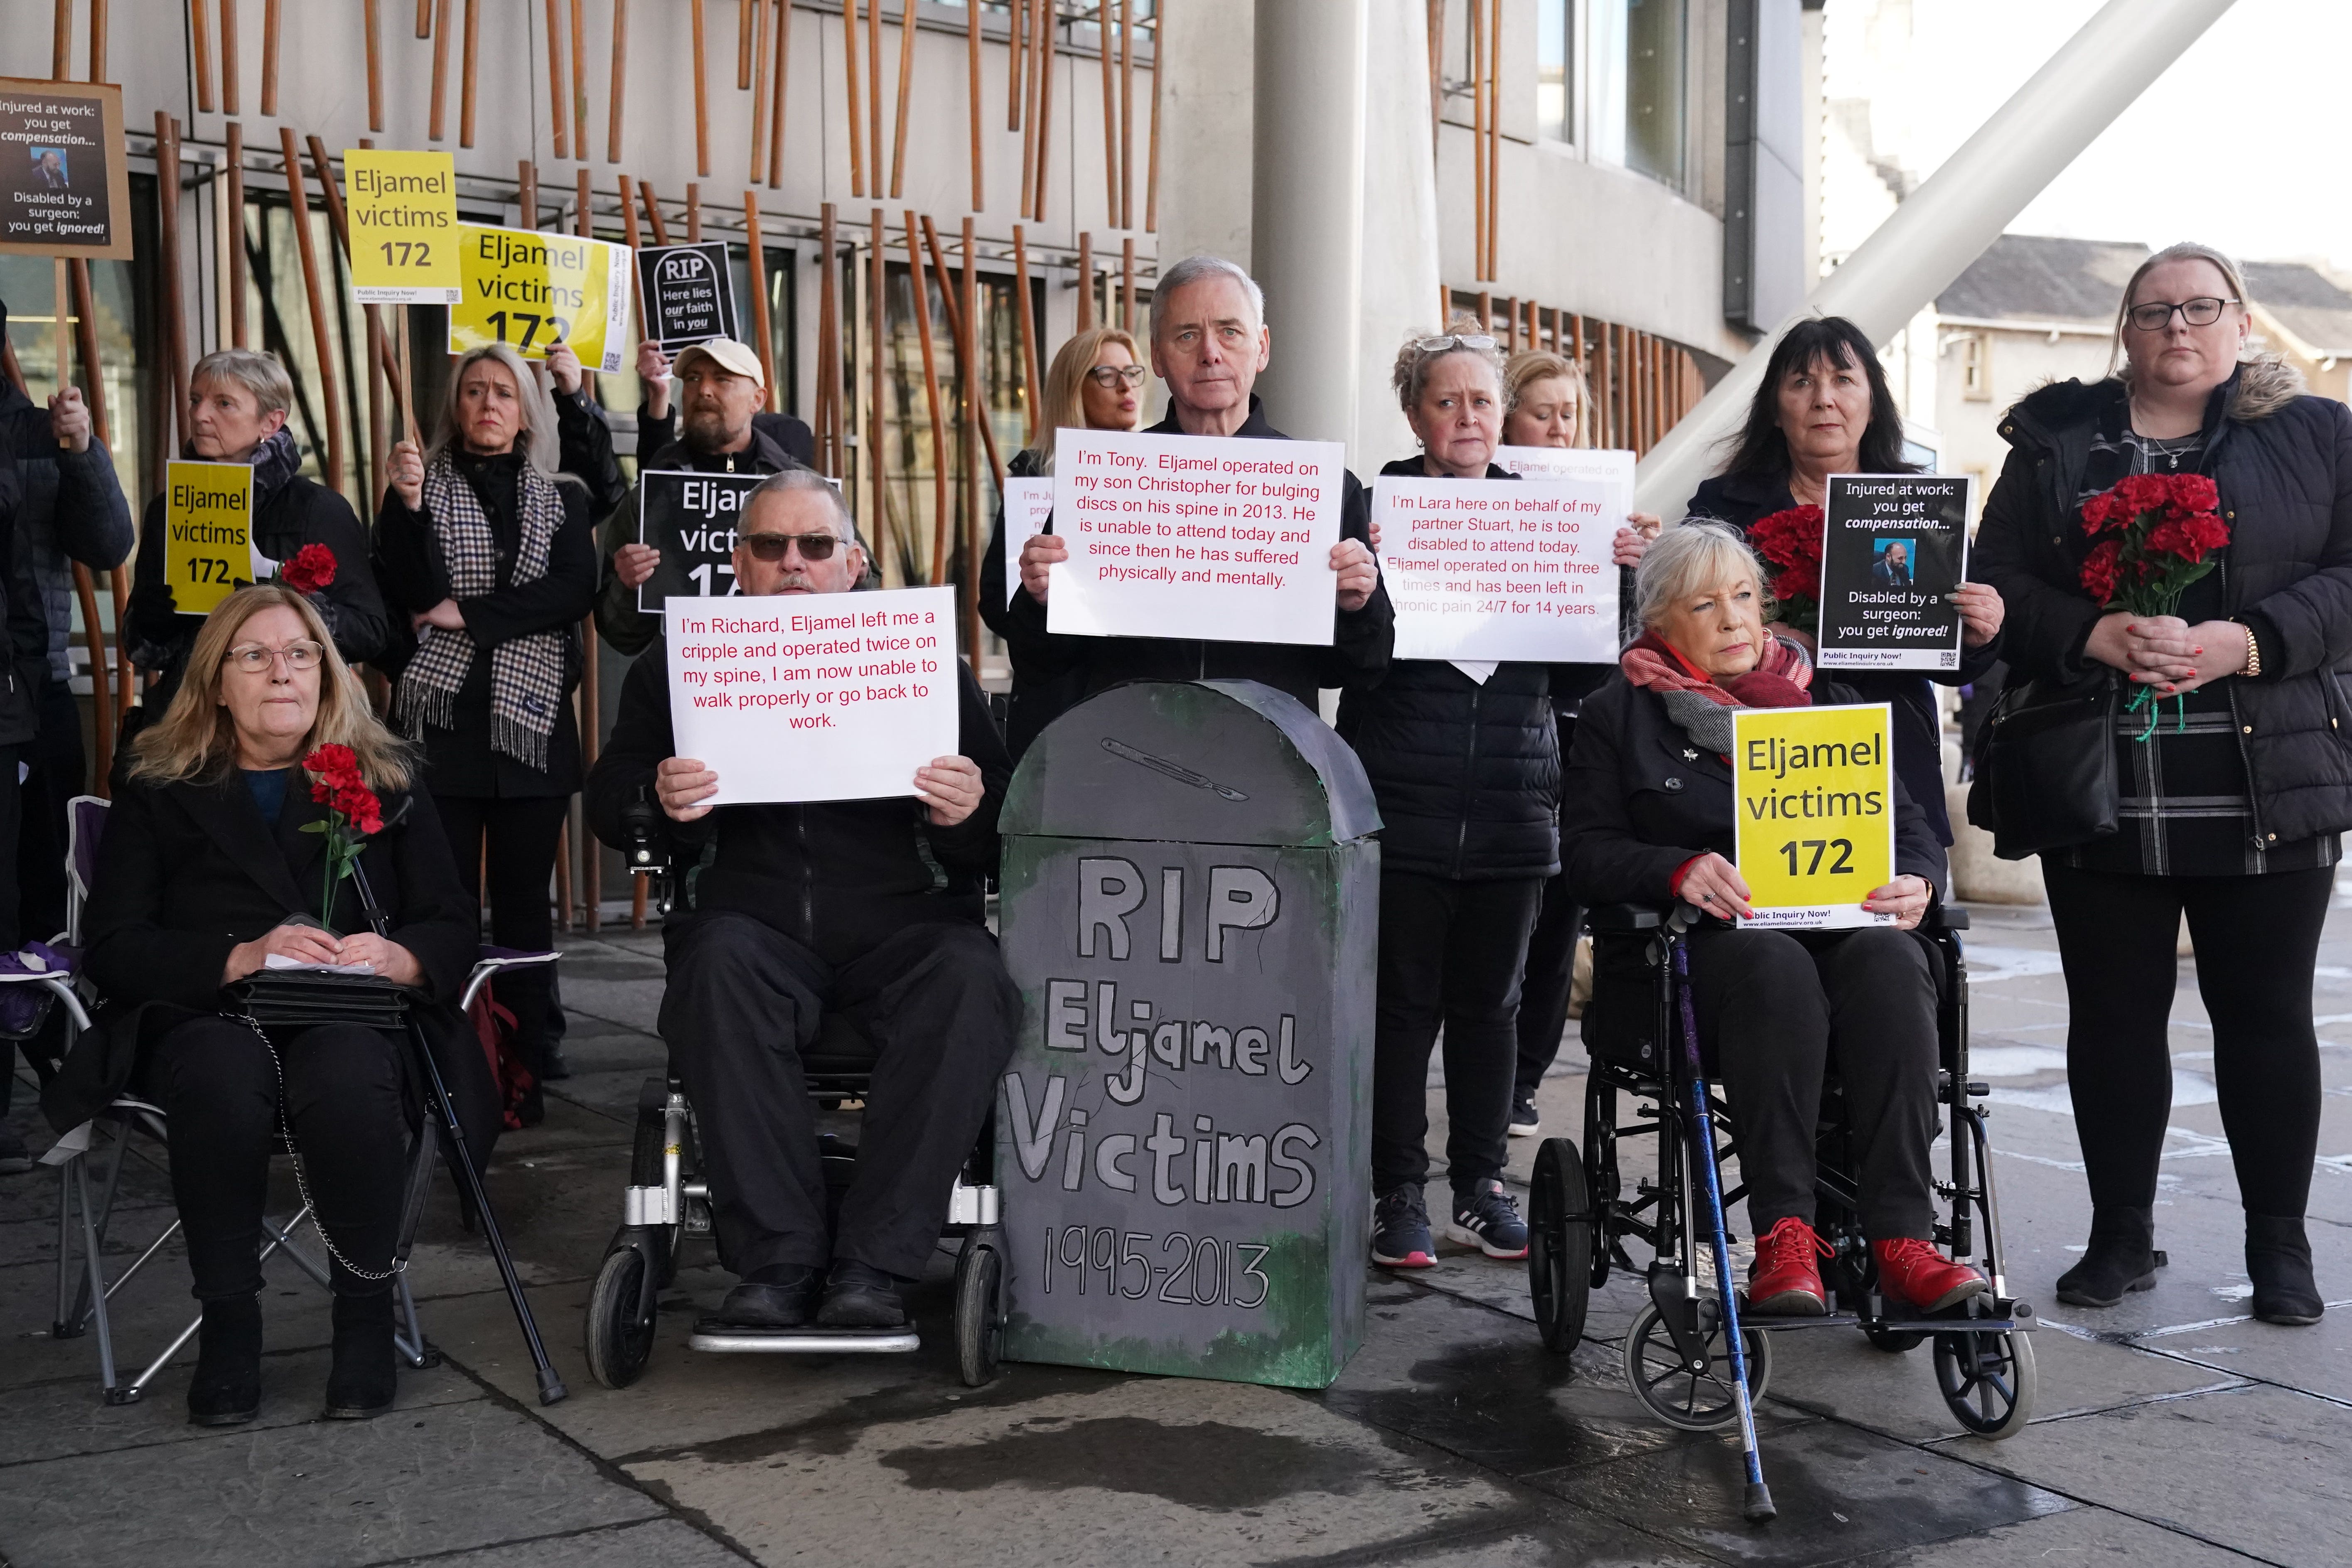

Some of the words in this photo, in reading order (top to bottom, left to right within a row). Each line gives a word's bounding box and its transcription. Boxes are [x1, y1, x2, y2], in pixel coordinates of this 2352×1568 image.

[46, 105, 58, 114] at
[61, 105, 94, 116] work:
[25, 119, 47, 130] you
[51, 120, 71, 131] get
[1, 132, 95, 145] compensation...
[355, 170, 445, 198] Eljamel
[14, 192, 64, 204] Disabled
[68, 194, 81, 207] by
[29, 209, 79, 220] surgeon:
[356, 204, 448, 227] victims
[9, 222, 30, 232] you
[34, 223, 54, 234] get
[57, 222, 104, 235] ignored!
[380, 242, 431, 266] 172
[480, 234, 582, 269] Eljamel
[665, 258, 704, 281] RIP
[477, 274, 583, 307] victims
[663, 291, 689, 301] Here
[693, 288, 712, 298] lies
[665, 306, 684, 317] our
[686, 302, 713, 313] faith
[485, 311, 570, 356] 172
[673, 319, 685, 329] in
[687, 319, 708, 331] you
[1079, 450, 1101, 465] I'm
[1107, 452, 1146, 470] Tony.
[1159, 455, 1217, 472] Eljamel
[1223, 461, 1293, 475] operated
[1300, 465, 1318, 475] on
[1510, 461, 1549, 473] Eljamel
[1553, 465, 1601, 475] operated
[174, 485, 246, 514] Eljamel
[1076, 477, 1098, 490] my
[1104, 478, 1131, 489] son
[1138, 476, 1231, 496] Christopher
[1236, 481, 1257, 495] for
[1263, 482, 1319, 501] bulging
[1846, 483, 1895, 498] Injured
[1899, 485, 1912, 495] at
[1916, 484, 1953, 495] work:
[1077, 496, 1117, 511] discs
[1123, 501, 1141, 512] on
[1148, 499, 1170, 513] his
[1176, 502, 1218, 518] spine
[1224, 503, 1236, 516] in
[1243, 504, 1286, 519] 2013.
[1294, 506, 1315, 521] He
[1394, 496, 1413, 508] I'm
[1420, 496, 1450, 509] Lara
[1456, 497, 1487, 510] here
[1493, 501, 1509, 510] on
[1515, 499, 1559, 511] behalf
[1563, 500, 1577, 512] of
[1581, 503, 1601, 516] my
[1873, 503, 1898, 515] you
[1903, 501, 1924, 515] get
[172, 520, 246, 545] victims
[1081, 518, 1092, 531] is
[1099, 521, 1151, 535] unable
[1157, 523, 1171, 536] to
[1177, 524, 1225, 538] attend
[1232, 527, 1275, 544] today
[1281, 530, 1310, 543] and
[1413, 518, 1463, 532] partner
[1468, 518, 1513, 533] Stuart,
[1520, 519, 1536, 531] he
[1542, 520, 1552, 532] is
[1558, 521, 1579, 533] too
[1846, 517, 1949, 531] compensation...
[1089, 541, 1130, 555] since
[1136, 543, 1169, 558] then
[1177, 545, 1195, 559] he
[1202, 547, 1229, 561] has
[1235, 549, 1298, 564] suffered
[1408, 538, 1467, 551] disabled
[1472, 539, 1485, 551] to
[1490, 540, 1534, 552] attend
[1539, 541, 1579, 556] today.
[188, 558, 230, 584] 172
[1099, 564, 1176, 584] physically
[1182, 569, 1210, 582] and
[1217, 572, 1285, 589] mentally.
[1388, 558, 1438, 571] Eljamel
[1444, 560, 1506, 574] operated
[1512, 563, 1528, 572] on
[1534, 560, 1558, 573] him
[1564, 561, 1599, 573] three
[1403, 578, 1440, 591] times
[1446, 580, 1470, 592] and
[1477, 580, 1501, 592] has
[1507, 580, 1540, 593] been
[1547, 581, 1567, 593] left
[1572, 582, 1583, 593] in
[1443, 600, 1471, 615] pain
[1477, 600, 1507, 613] 24/7
[1512, 601, 1530, 613] for
[1536, 602, 1551, 613] 14
[1557, 605, 1598, 617] years.
[1849, 591, 1905, 603] Disabled
[1910, 592, 1926, 607] by
[683, 619, 705, 633] I'm
[713, 617, 784, 634] Richard,
[792, 613, 855, 634] Eljamel
[862, 612, 887, 627] left
[893, 613, 918, 625] me
[925, 612, 934, 623] a
[1863, 611, 1921, 622] surgeon:
[1838, 627, 1863, 639] you
[1867, 626, 1889, 639] get
[1892, 624, 1948, 639] ignored!
[683, 643, 737, 662] cripple
[744, 642, 776, 657] and
[783, 638, 860, 659] operated
[866, 636, 909, 651] twice
[916, 637, 936, 648] on
[684, 672, 707, 687] my
[714, 668, 765, 686] spine,
[774, 666, 776, 681] I
[784, 669, 810, 681] am
[818, 666, 852, 678] now
[859, 659, 915, 676] unable
[922, 659, 936, 672] to
[693, 693, 732, 707] walk
[739, 690, 810, 710] properly
[816, 692, 833, 703] or
[840, 691, 860, 705] go
[867, 684, 907, 700] back
[913, 683, 928, 697] to
[789, 713, 836, 728] work.
[1748, 733, 1880, 779] Eljamel
[1747, 786, 1882, 820] victims
[1779, 838, 1853, 876] 172
[1077, 856, 1280, 963] RIP
[1773, 911, 1805, 920] Inquiry
[1043, 978, 1313, 1106] Eljamel
[1003, 1071, 1321, 1209] Victims
[1043, 1224, 1271, 1308] 1995-2013
